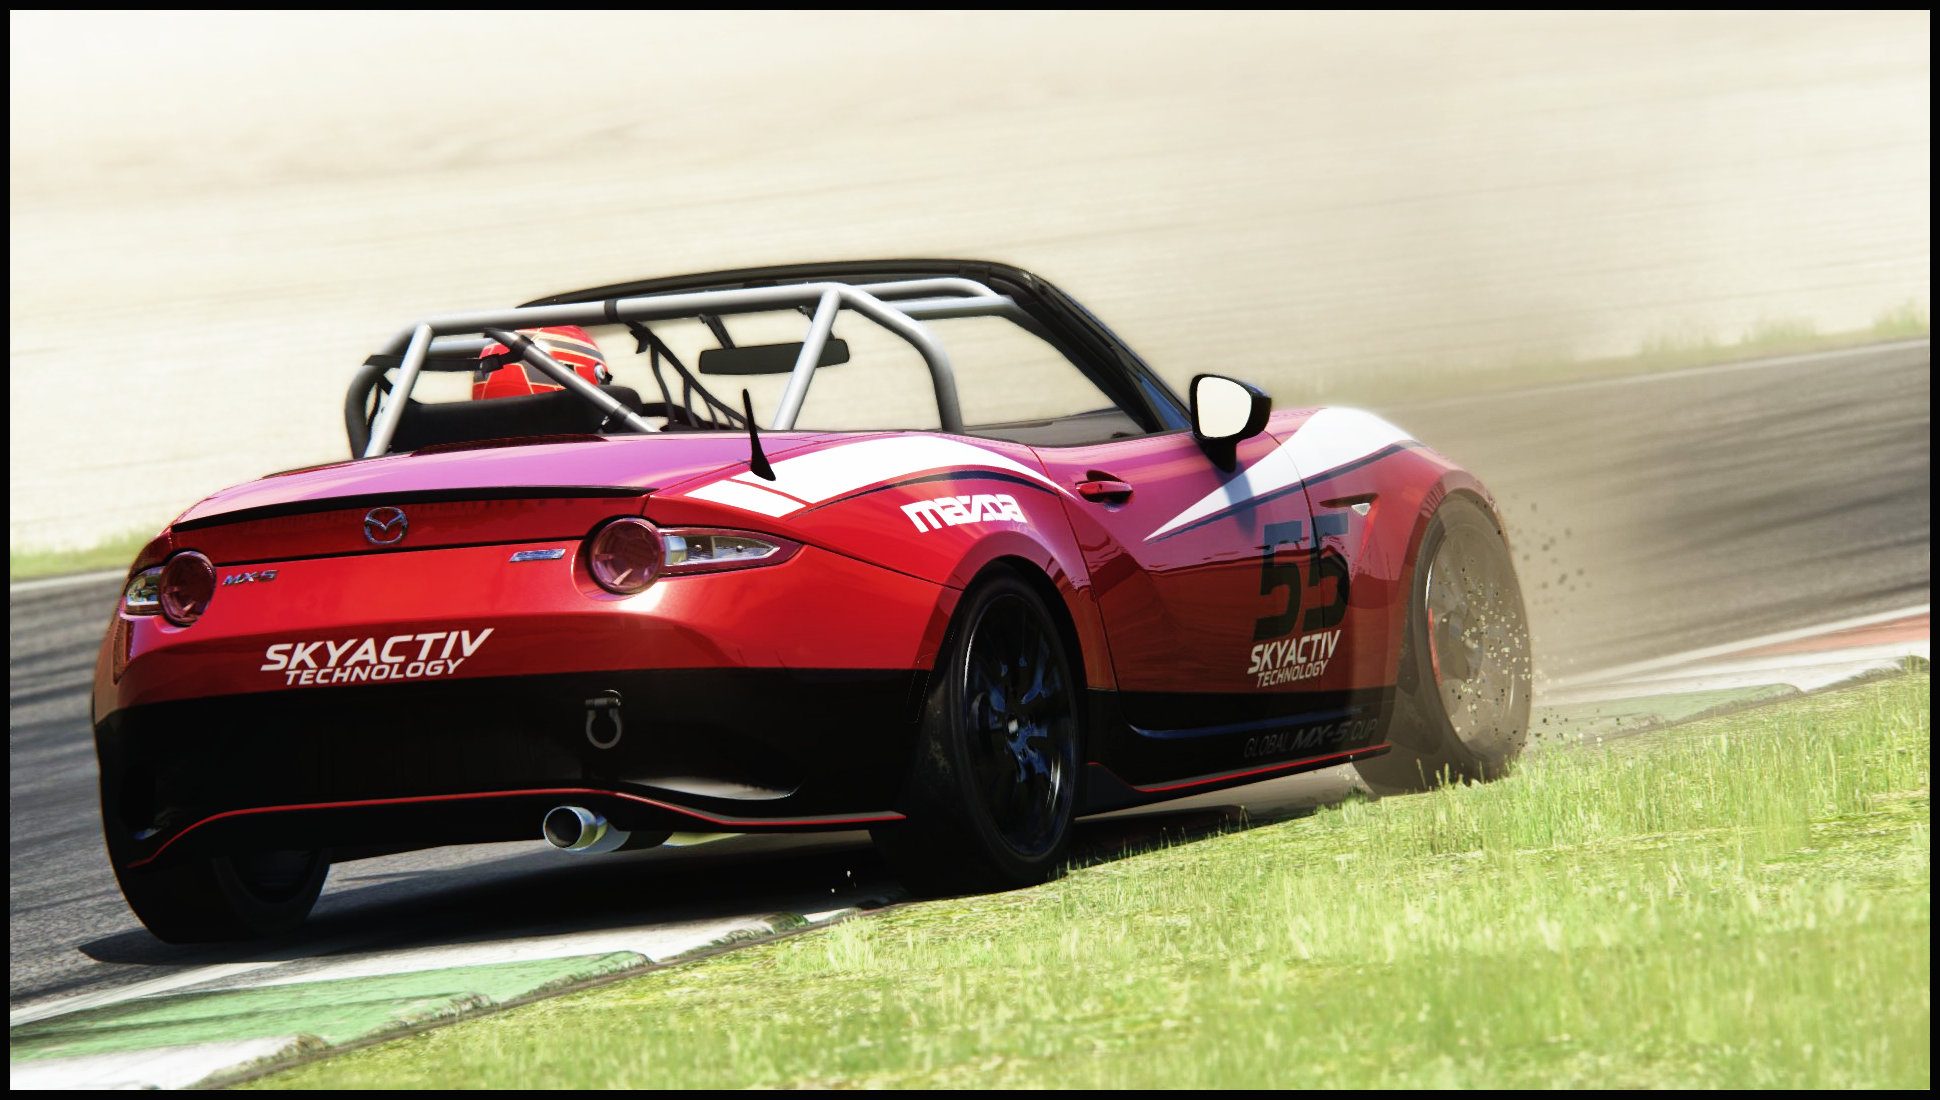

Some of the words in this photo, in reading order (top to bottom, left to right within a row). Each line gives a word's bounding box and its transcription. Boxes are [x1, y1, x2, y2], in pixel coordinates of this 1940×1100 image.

[222, 570, 279, 586] MX-5
[1253, 512, 1349, 640] 55
[261, 628, 495, 671] SKYACTIV
[1247, 629, 1342, 675] SKYACTIV
[285, 657, 465, 686] TECHNOLOGY
[1256, 659, 1329, 688] TECHNOLOGY
[1244, 733, 1288, 758] GLOBAL
[1290, 721, 1350, 750] MX-5
[1351, 718, 1378, 741] CUP
